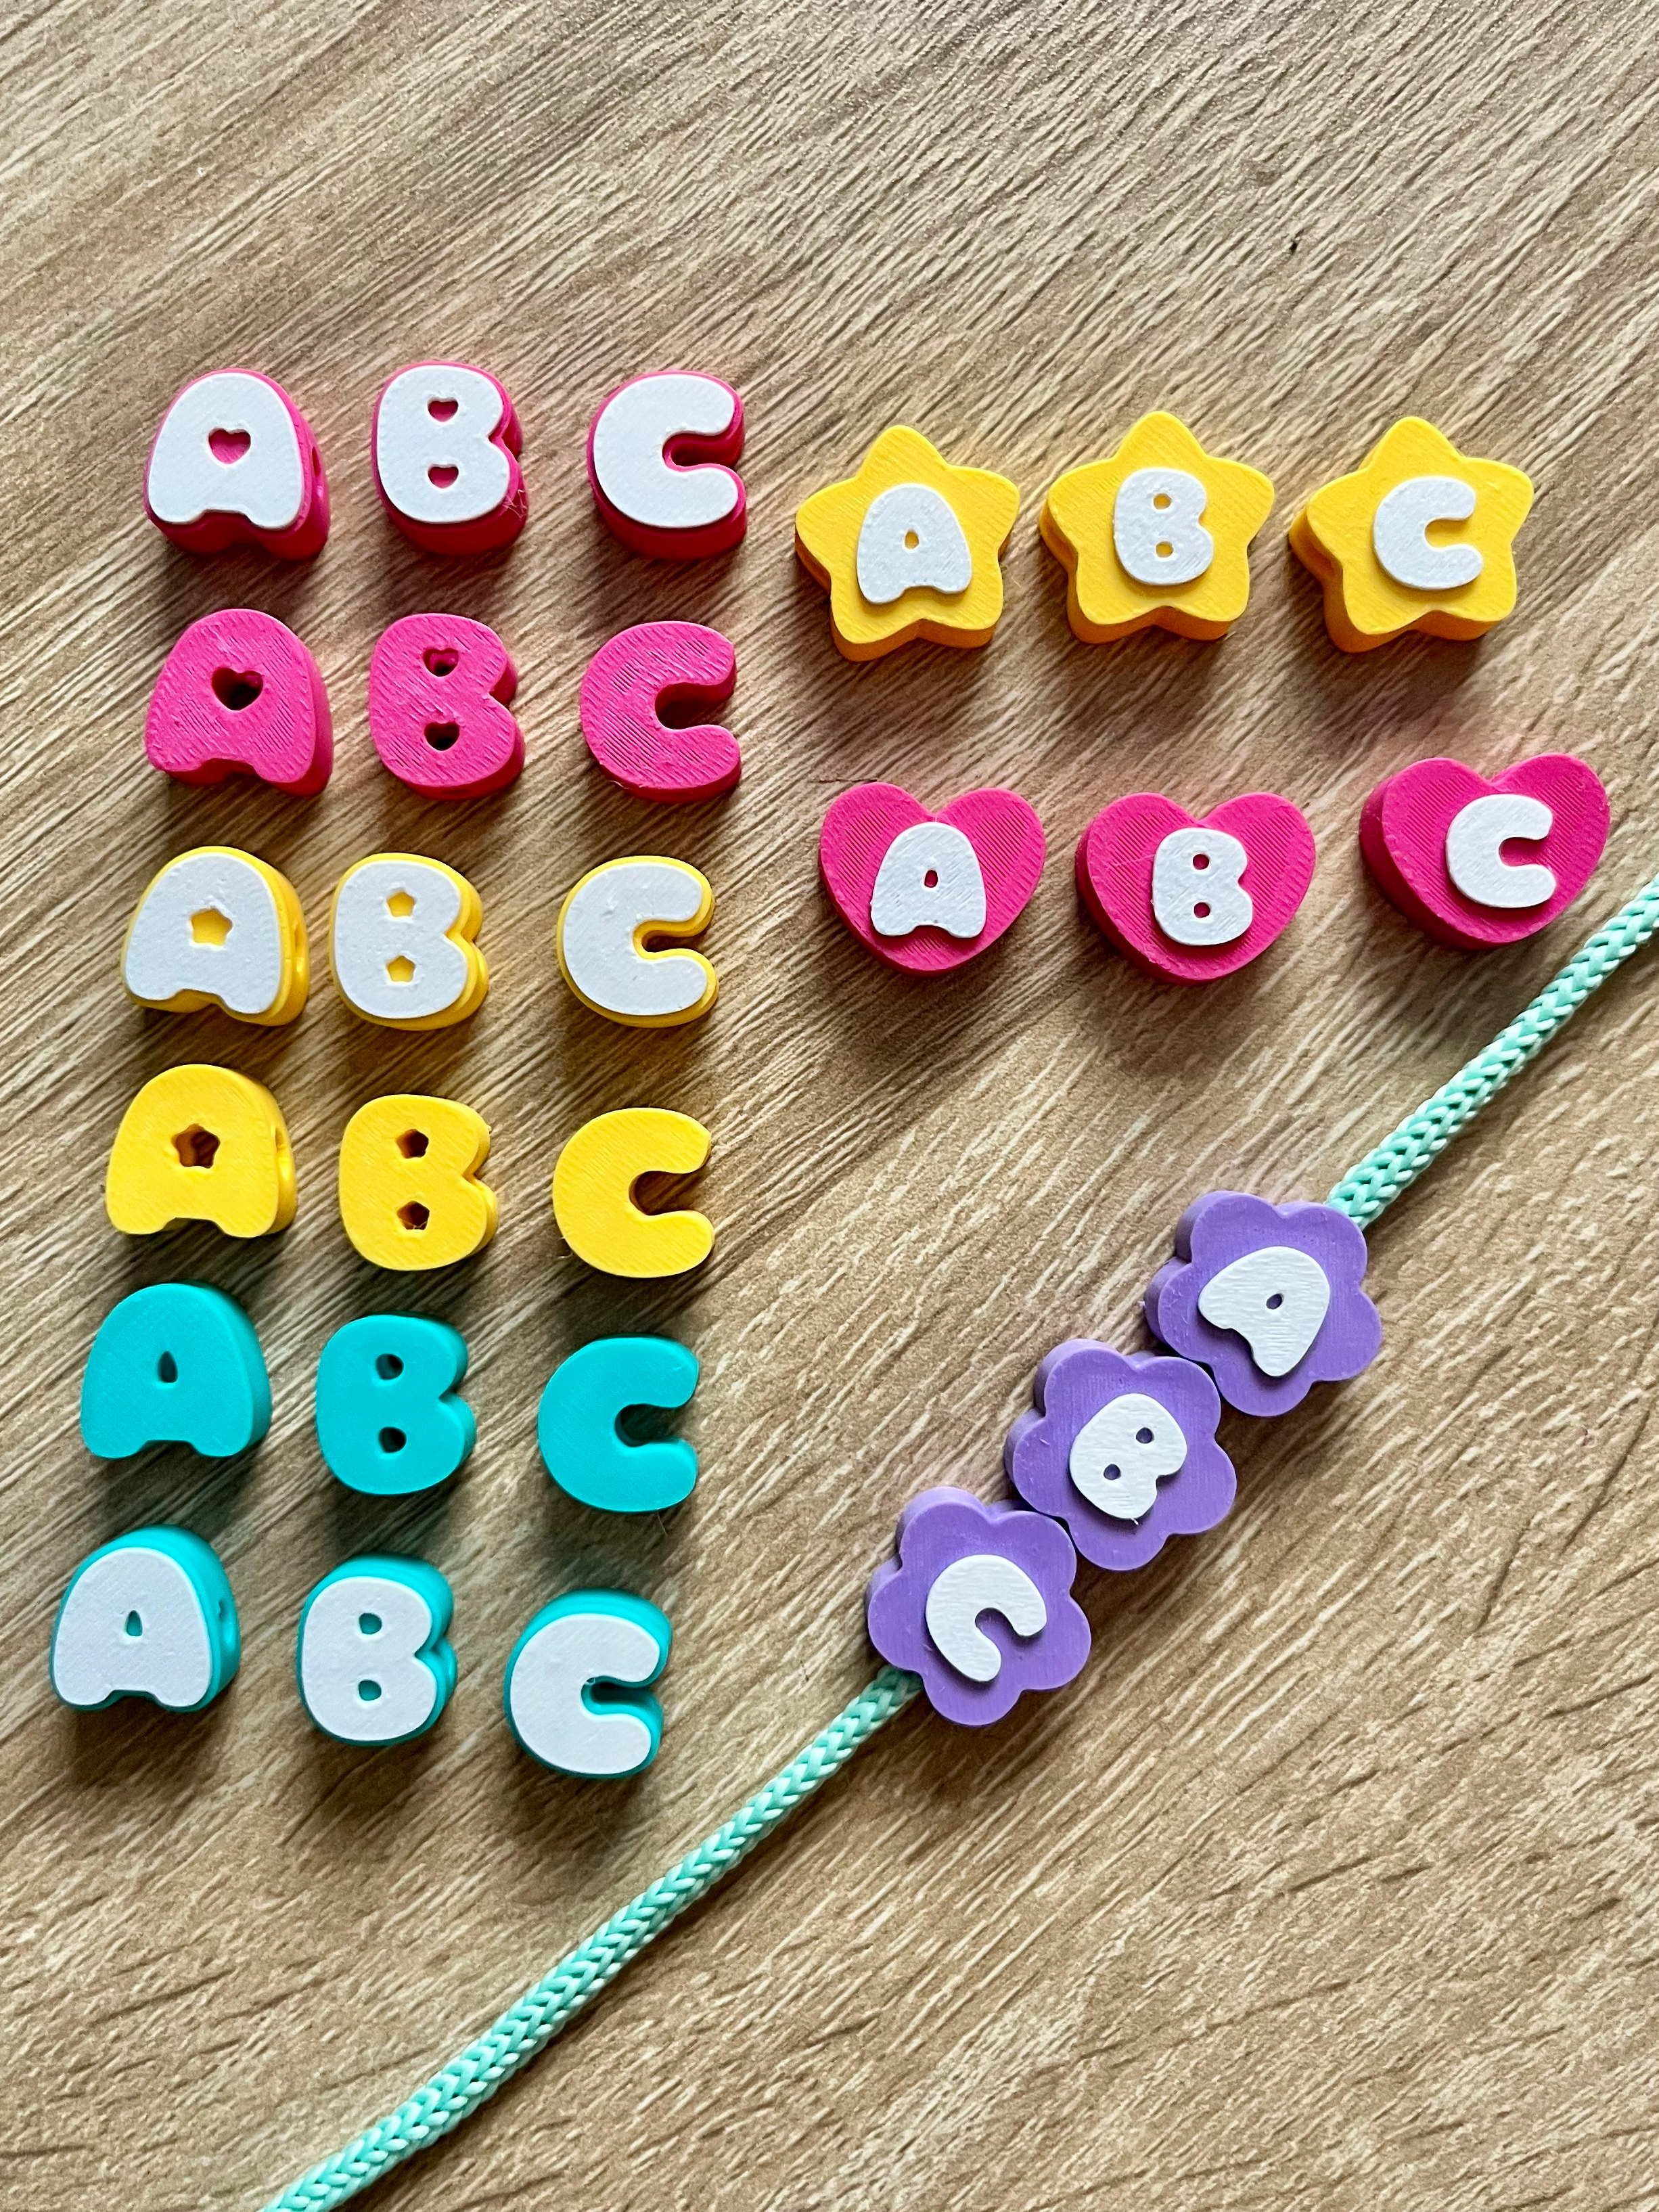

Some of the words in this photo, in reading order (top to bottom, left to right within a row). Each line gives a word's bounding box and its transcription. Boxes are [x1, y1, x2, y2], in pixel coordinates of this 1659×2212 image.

[147, 371, 304, 529] A
[376, 364, 511, 524] B
[592, 373, 740, 529] C
[856, 482, 972, 604] A
[1112, 466, 1214, 587] B
[1372, 475, 1484, 590] C
[145, 608, 332, 796] A
[369, 612, 526, 800] B
[580, 620, 742, 803] C
[123, 853, 282, 1015] A
[334, 859, 472, 1020] B
[562, 861, 708, 1016] C
[870, 821, 987, 939] A
[1152, 826, 1254, 947] B
[1445, 793, 1558, 909] C
[105, 1064, 299, 1238] A
[339, 1093, 499, 1271] B
[551, 1107, 714, 1278] C
[1198, 1245, 1332, 1378] A
[81, 1282, 272, 1458] A
[315, 1314, 476, 1495] B
[537, 1336, 699, 1512] C
[1068, 1393, 1188, 1520] B
[53, 1546, 213, 1708] A
[302, 1575, 436, 1742] B
[510, 1613, 661, 1776] C
[925, 1554, 1048, 1683] C
